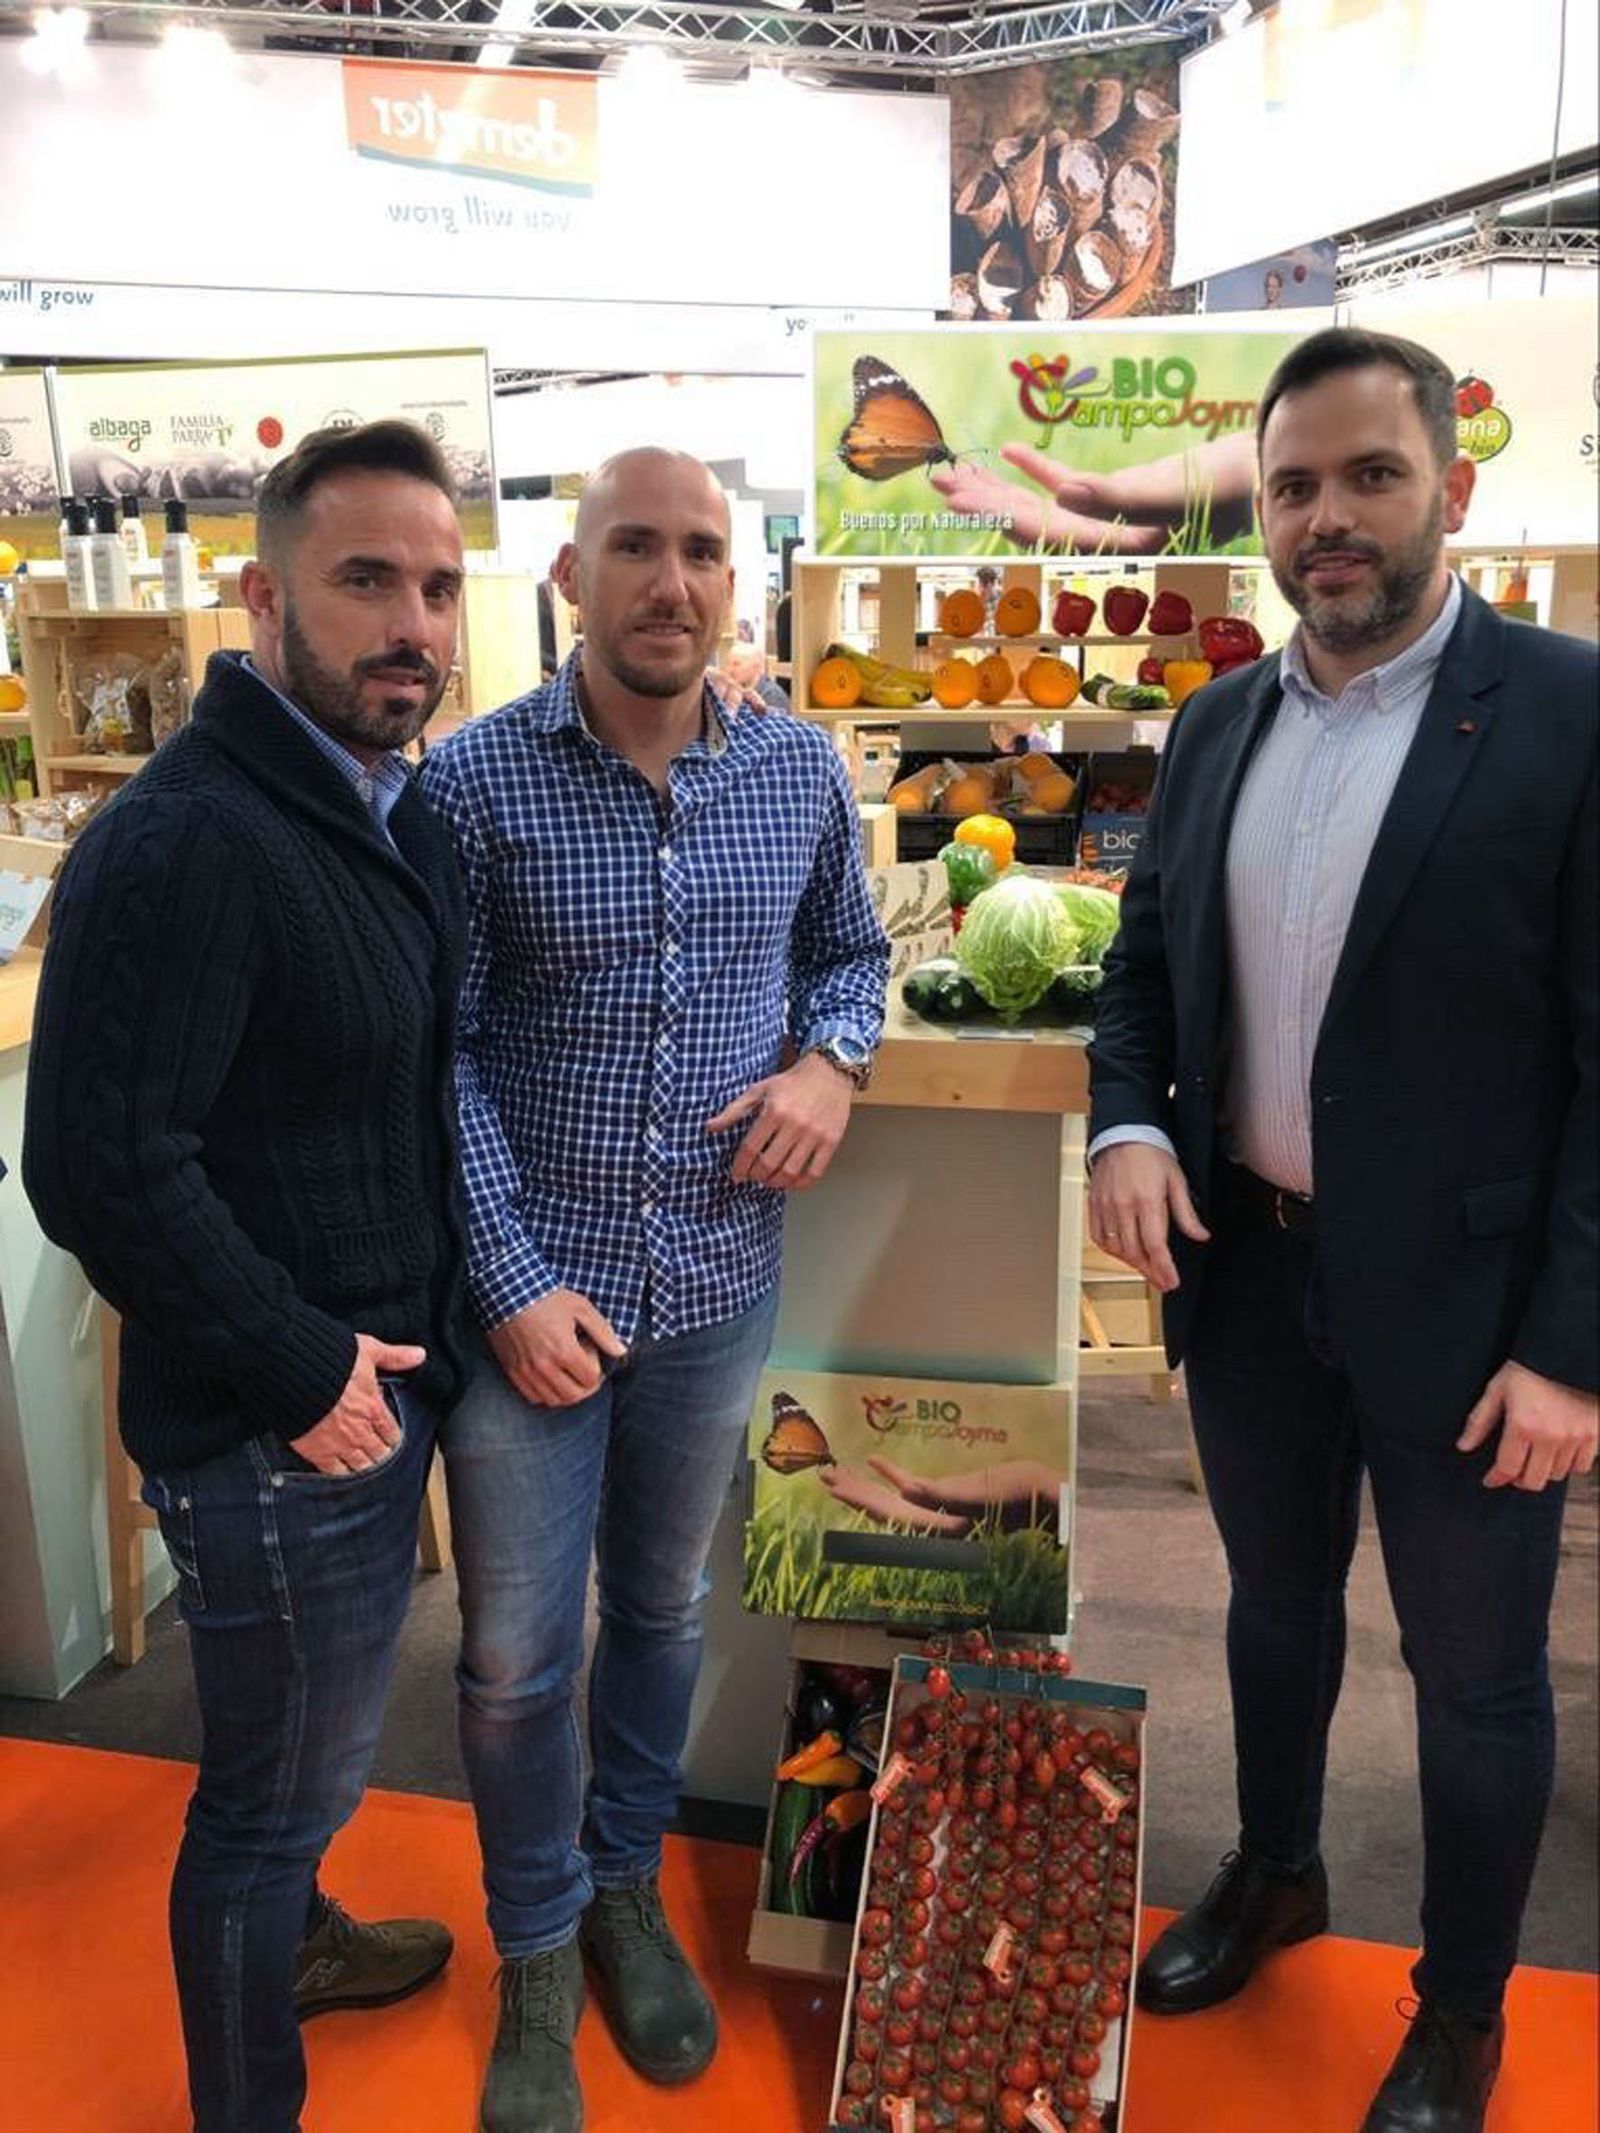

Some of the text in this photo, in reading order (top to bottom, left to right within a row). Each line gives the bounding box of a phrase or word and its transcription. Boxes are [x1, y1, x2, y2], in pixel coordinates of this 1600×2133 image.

[40, 290, 94, 311] grow
[785, 316, 807, 336] yo
[1112, 357, 1197, 399] BIO
[1011, 360, 1258, 449] CampoJoym
[1457, 419, 1501, 438] ana
[840, 509, 1013, 535] Buenos por Naturaleza
[916, 1399, 961, 1422] BIO
